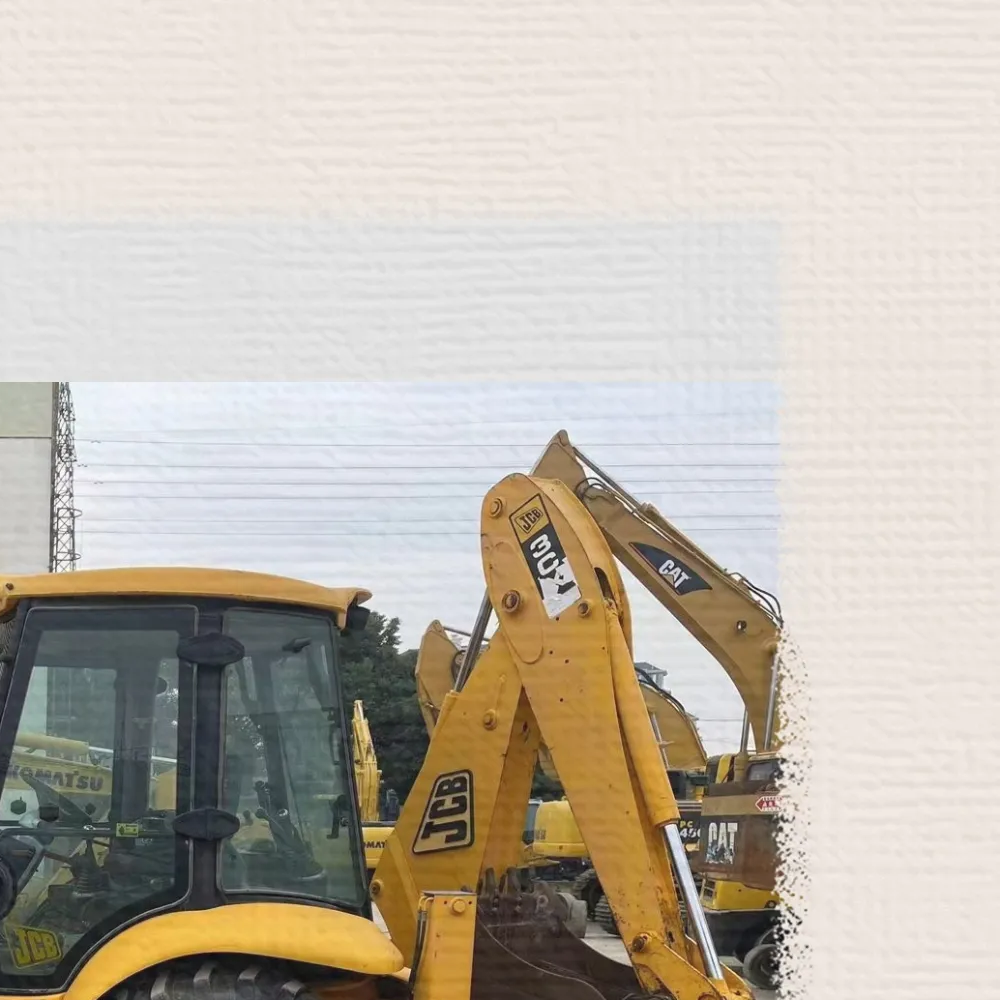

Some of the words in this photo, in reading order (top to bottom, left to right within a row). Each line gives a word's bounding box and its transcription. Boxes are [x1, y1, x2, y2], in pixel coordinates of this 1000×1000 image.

[519, 508, 542, 531] JCB
[658, 559, 690, 589] CAT
[420, 775, 468, 844] JCB
[680, 820, 694, 829] PC
[705, 822, 739, 865] CAT
[12, 927, 59, 965] JCB
